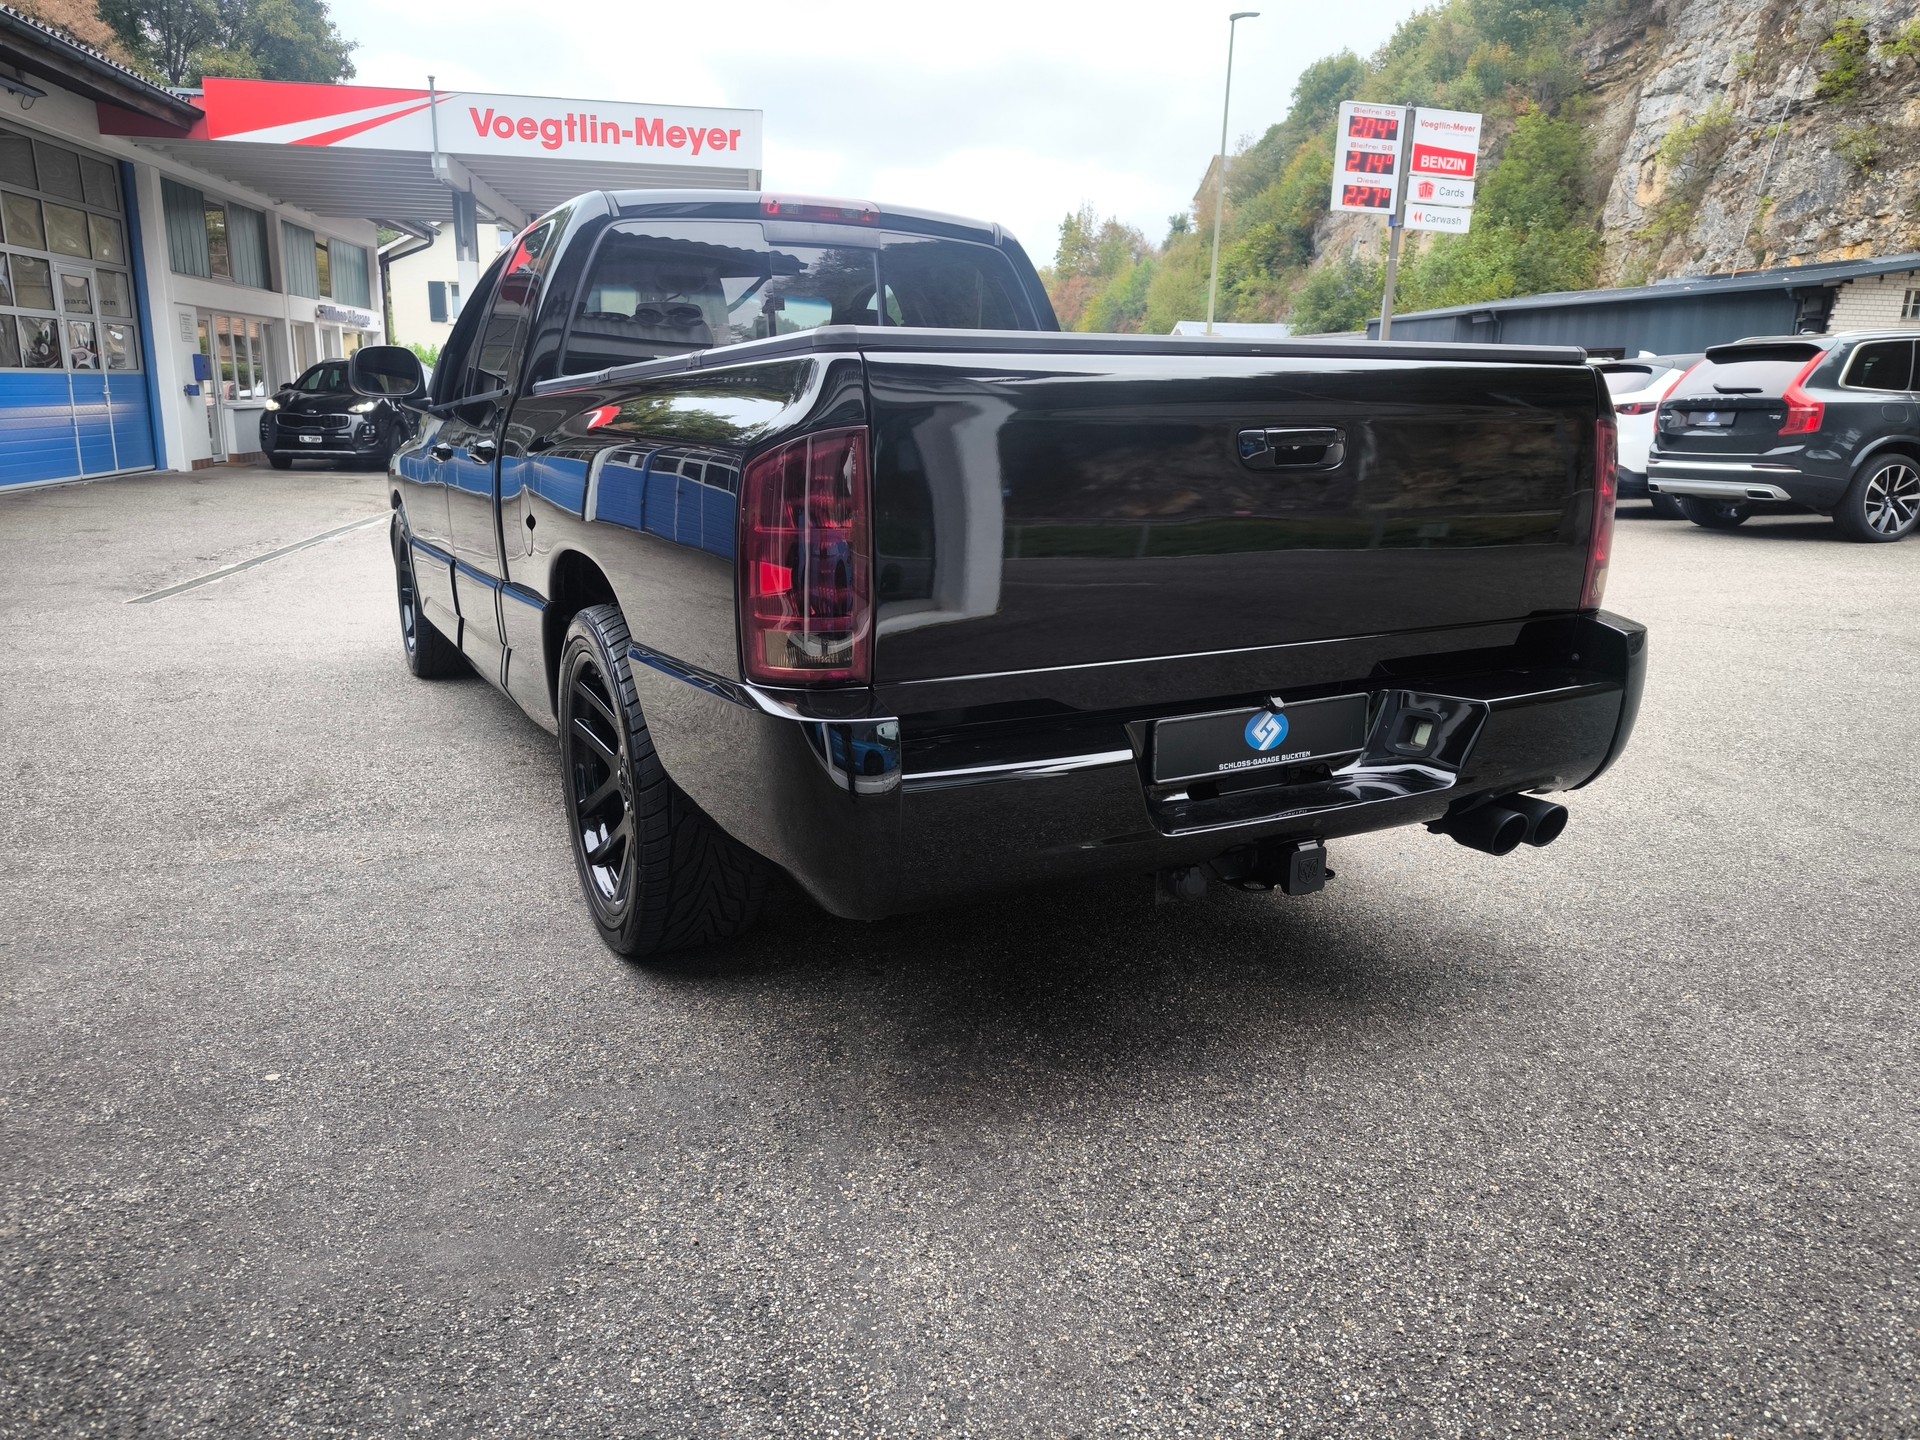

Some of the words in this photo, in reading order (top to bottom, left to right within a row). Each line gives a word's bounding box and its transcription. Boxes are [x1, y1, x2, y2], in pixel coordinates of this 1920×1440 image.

[1353, 107, 1382, 115] Bleifrei
[469, 107, 741, 156] Voegtlin-Meyer
[1420, 119, 1476, 133] Voegtlin-Meyer
[1350, 141, 1379, 150] Bleifrei
[1420, 155, 1467, 171] BENZIN
[1356, 177, 1381, 185] Diesel
[1439, 187, 1465, 198] Cards
[1425, 213, 1462, 225] Carwash
[1219, 755, 1280, 770] SCHLOSS-GARAGE
[1281, 750, 1311, 761] BUCKTEN
